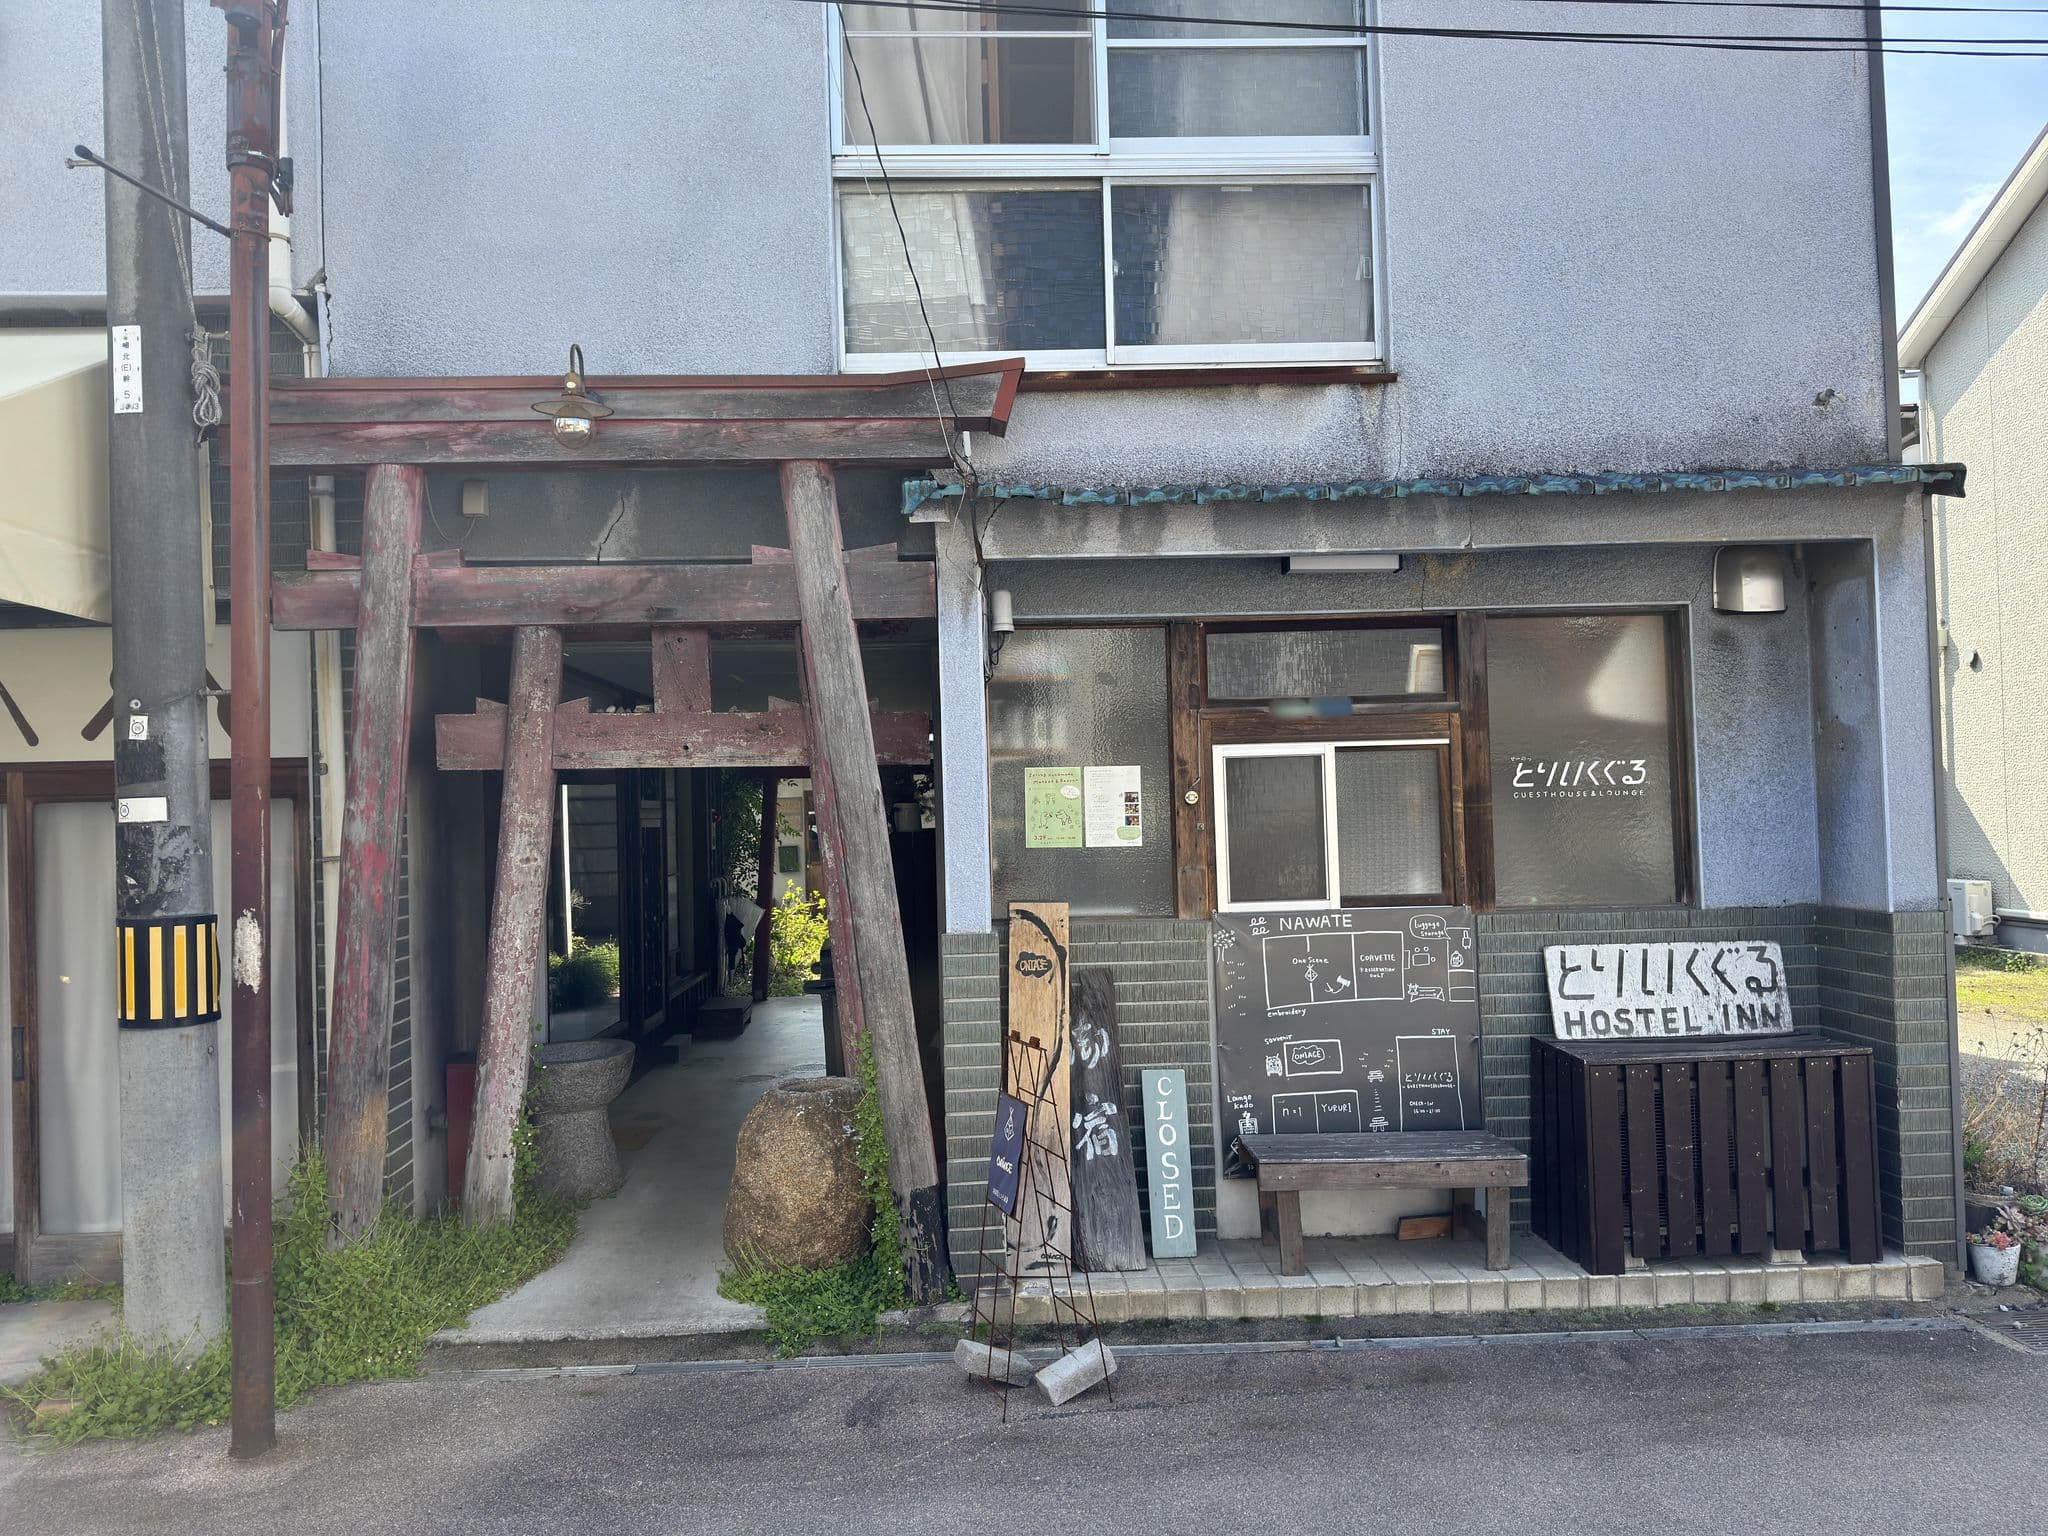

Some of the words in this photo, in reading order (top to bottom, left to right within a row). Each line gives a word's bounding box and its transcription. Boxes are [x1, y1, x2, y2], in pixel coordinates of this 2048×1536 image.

[1512, 759, 1647, 788] とりいくぐる
[1279, 913, 1353, 931] NAWATE
[1359, 953, 1397, 962] CORVETTE
[1558, 945, 1778, 1001] とりいくぐる
[1267, 1007, 1306, 1018] embroidery
[1431, 1027, 1451, 1036] STAY
[1320, 1102, 1352, 1113] YURURI
[1156, 1075, 1185, 1240] CLOSED
